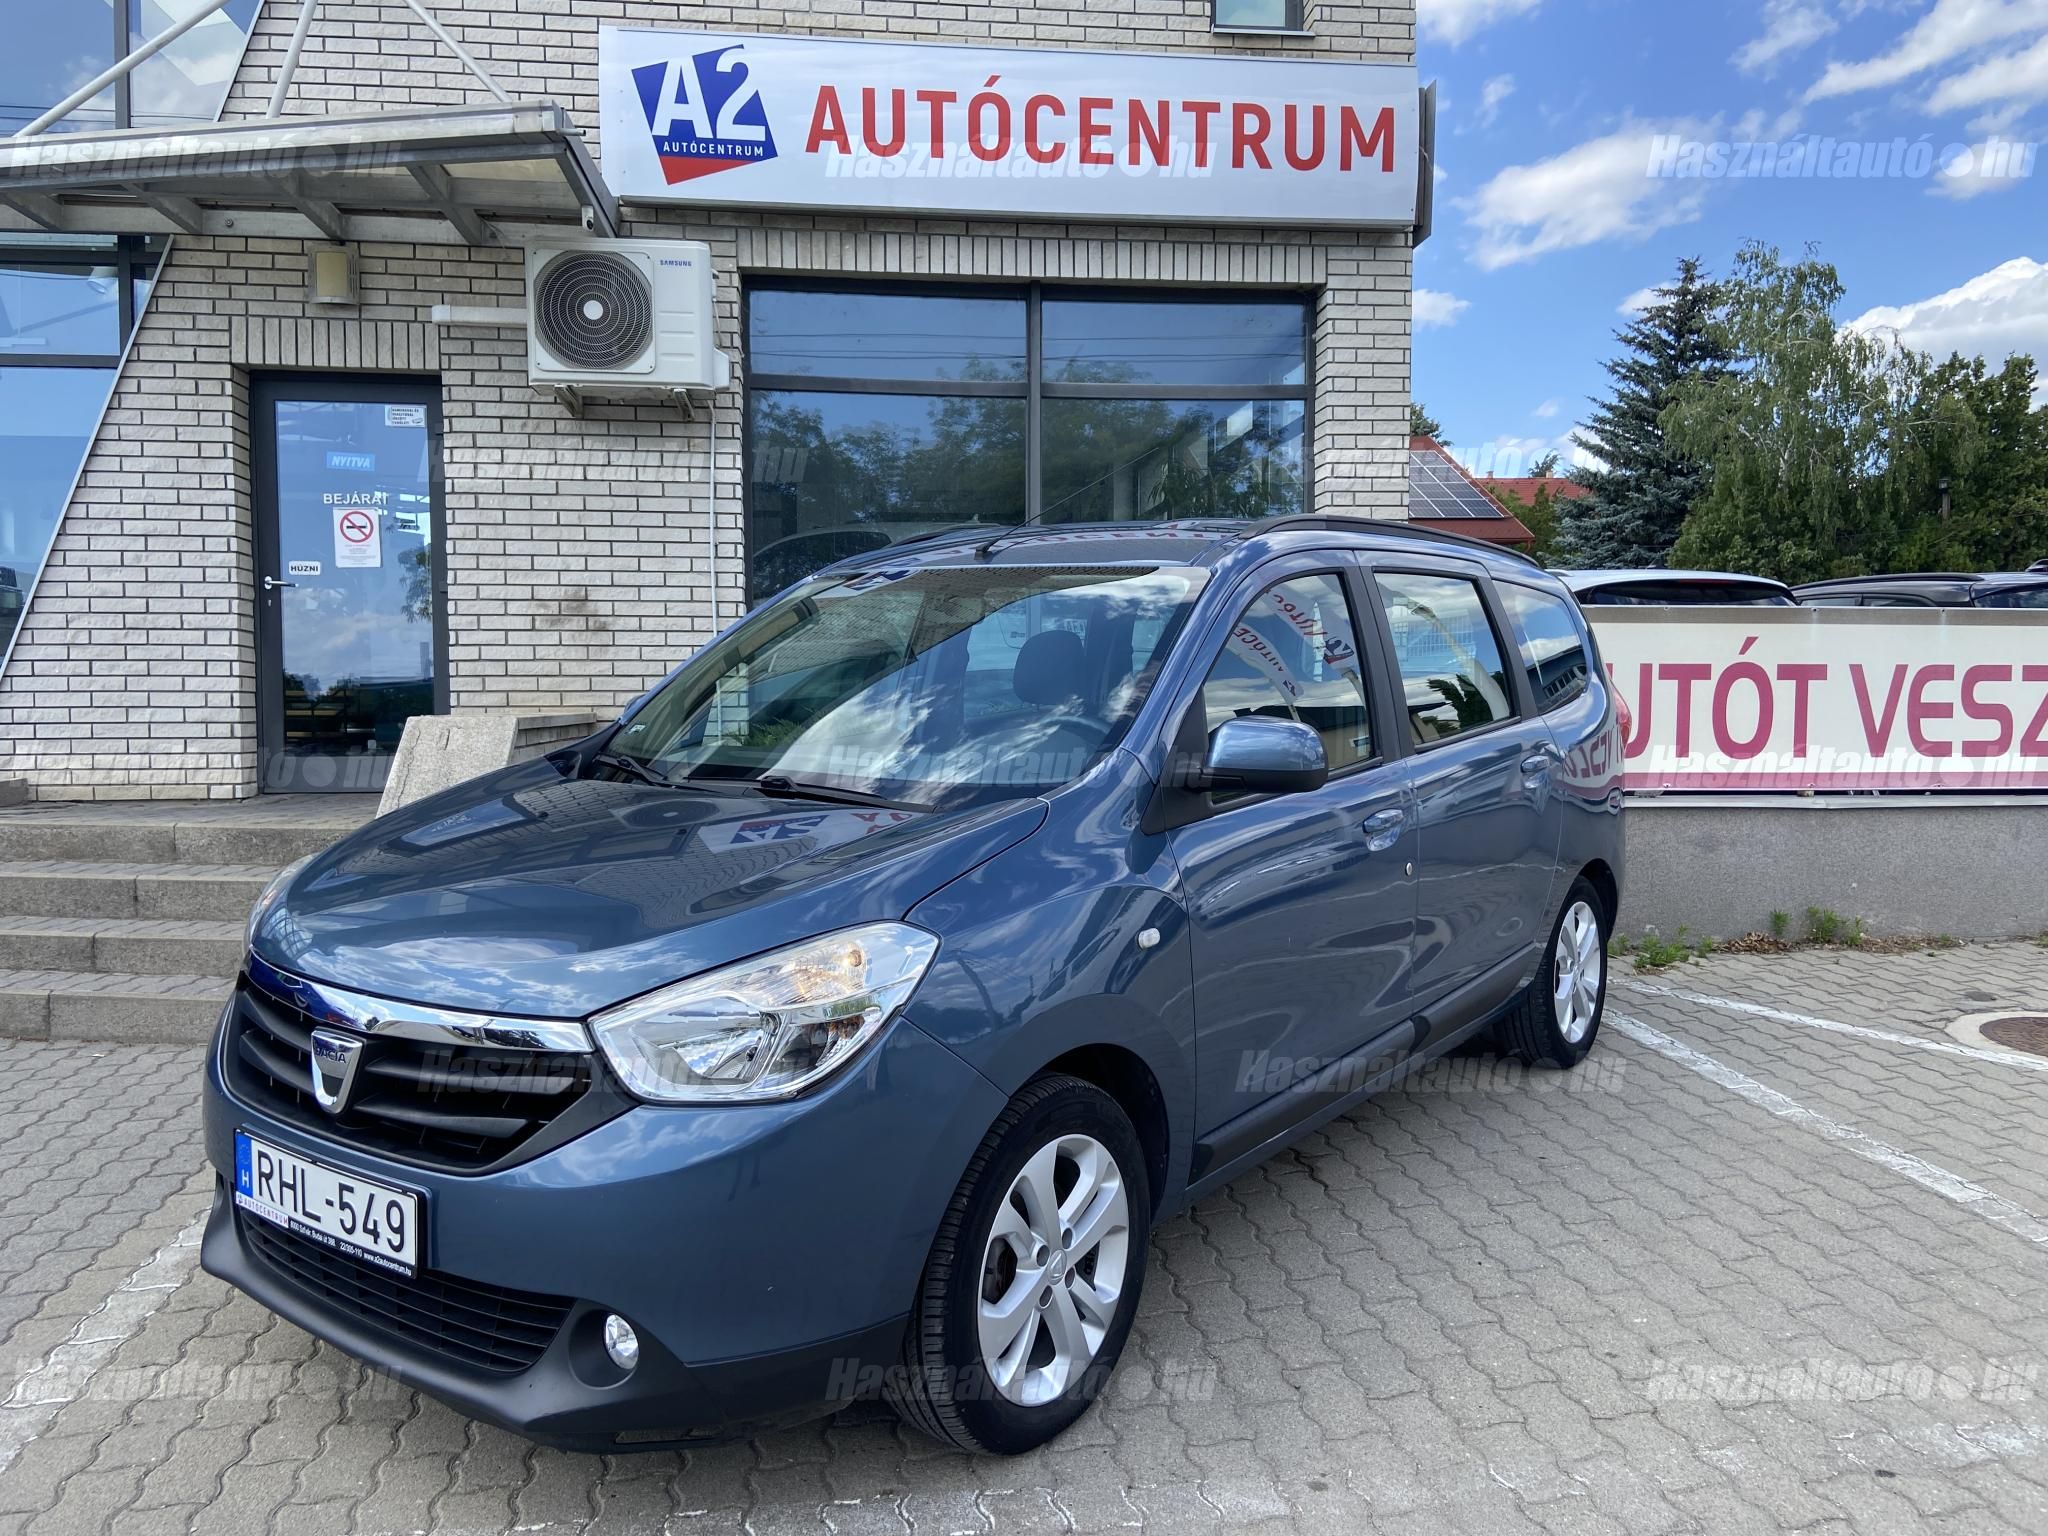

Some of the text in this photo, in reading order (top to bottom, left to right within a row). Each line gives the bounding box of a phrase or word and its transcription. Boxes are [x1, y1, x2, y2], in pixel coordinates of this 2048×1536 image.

[651, 47, 766, 141] A2
[804, 75, 1397, 173] AUTÓCENTRUM
[663, 140, 764, 157] AUTÓCENTRUM
[660, 259, 693, 267] SAMSUNG
[331, 456, 370, 468] NYITVA
[323, 491, 389, 505] BEJÁRAT
[257, 1149, 405, 1253] RHL-549
